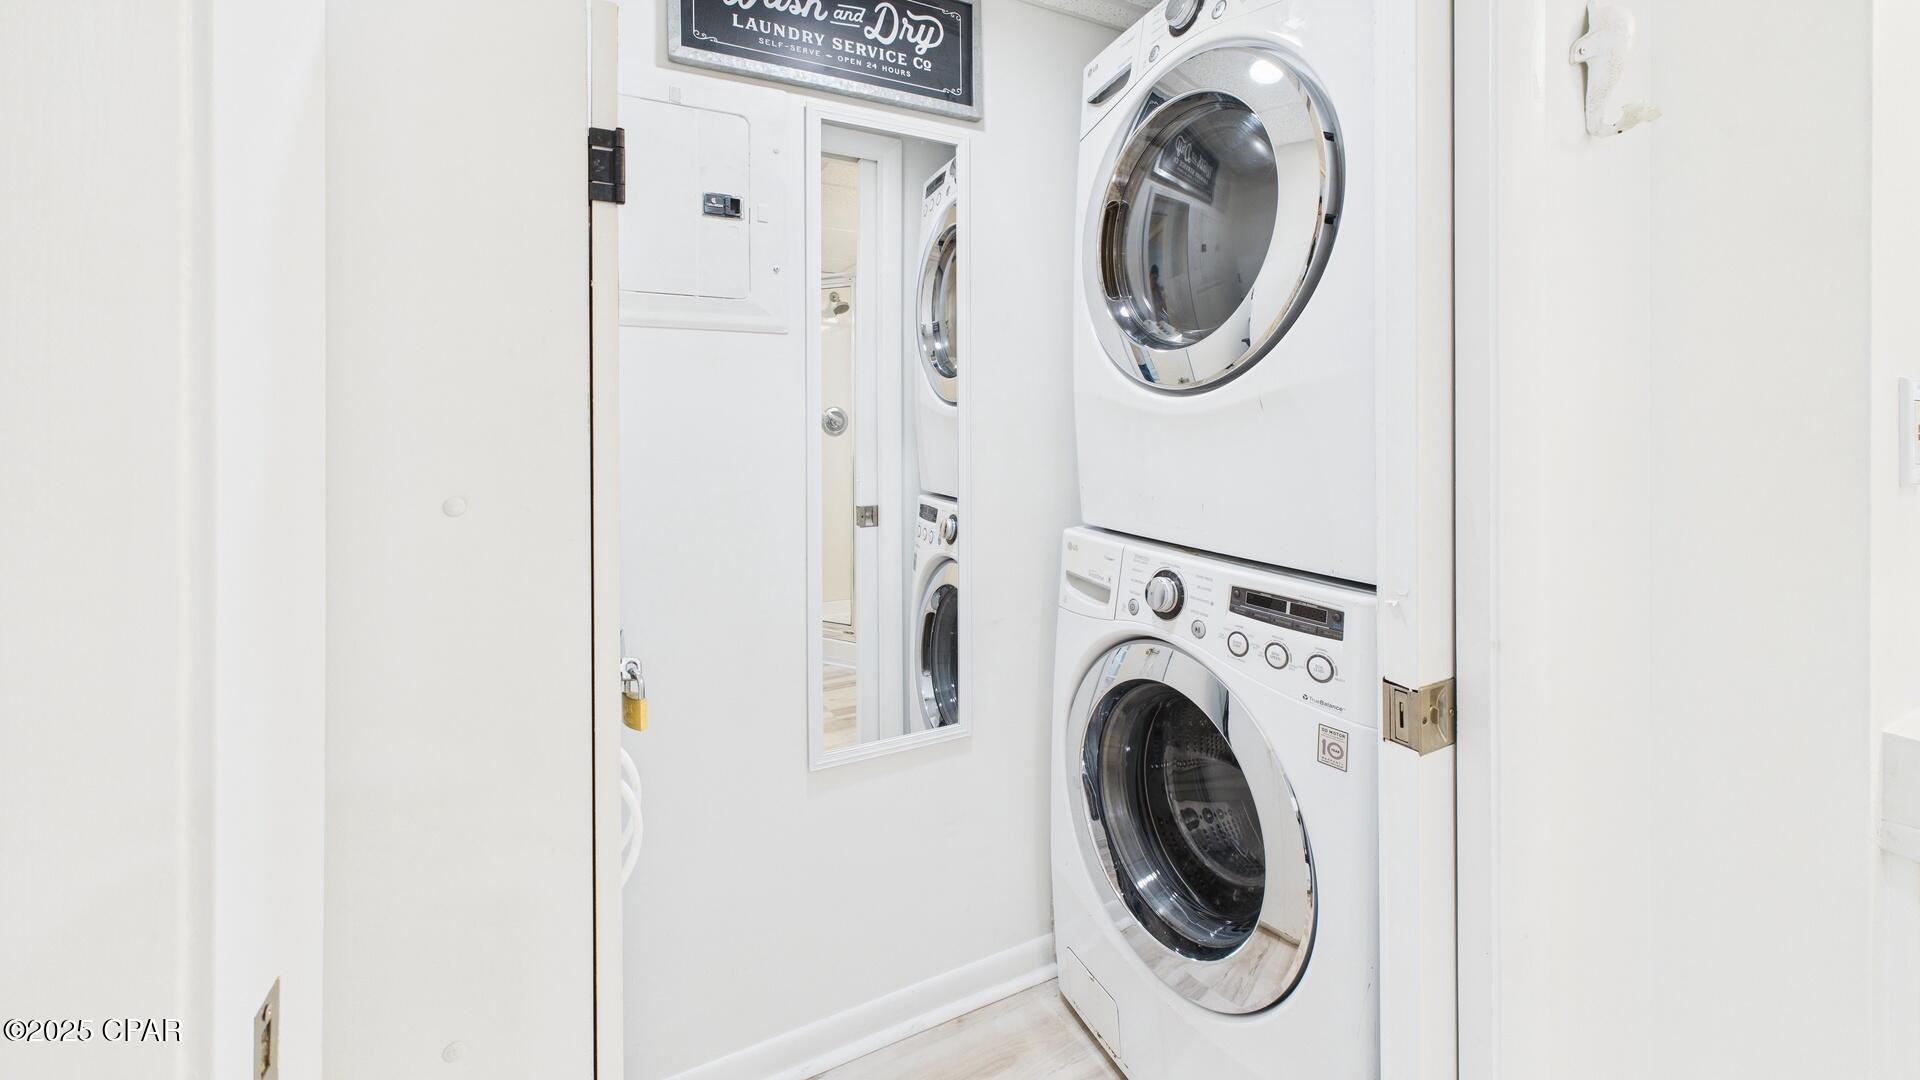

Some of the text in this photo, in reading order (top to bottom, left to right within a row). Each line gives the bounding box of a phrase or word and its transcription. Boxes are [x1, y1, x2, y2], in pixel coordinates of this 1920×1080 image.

[732, 14, 932, 71] LAUNDRY SERVICE Co
[832, 8, 864, 24] and
[864, 2, 944, 54] Dry
[758, 37, 911, 77] SELF-SERVE OPEN 24 HOURS
[1321, 739, 1344, 760] 10
